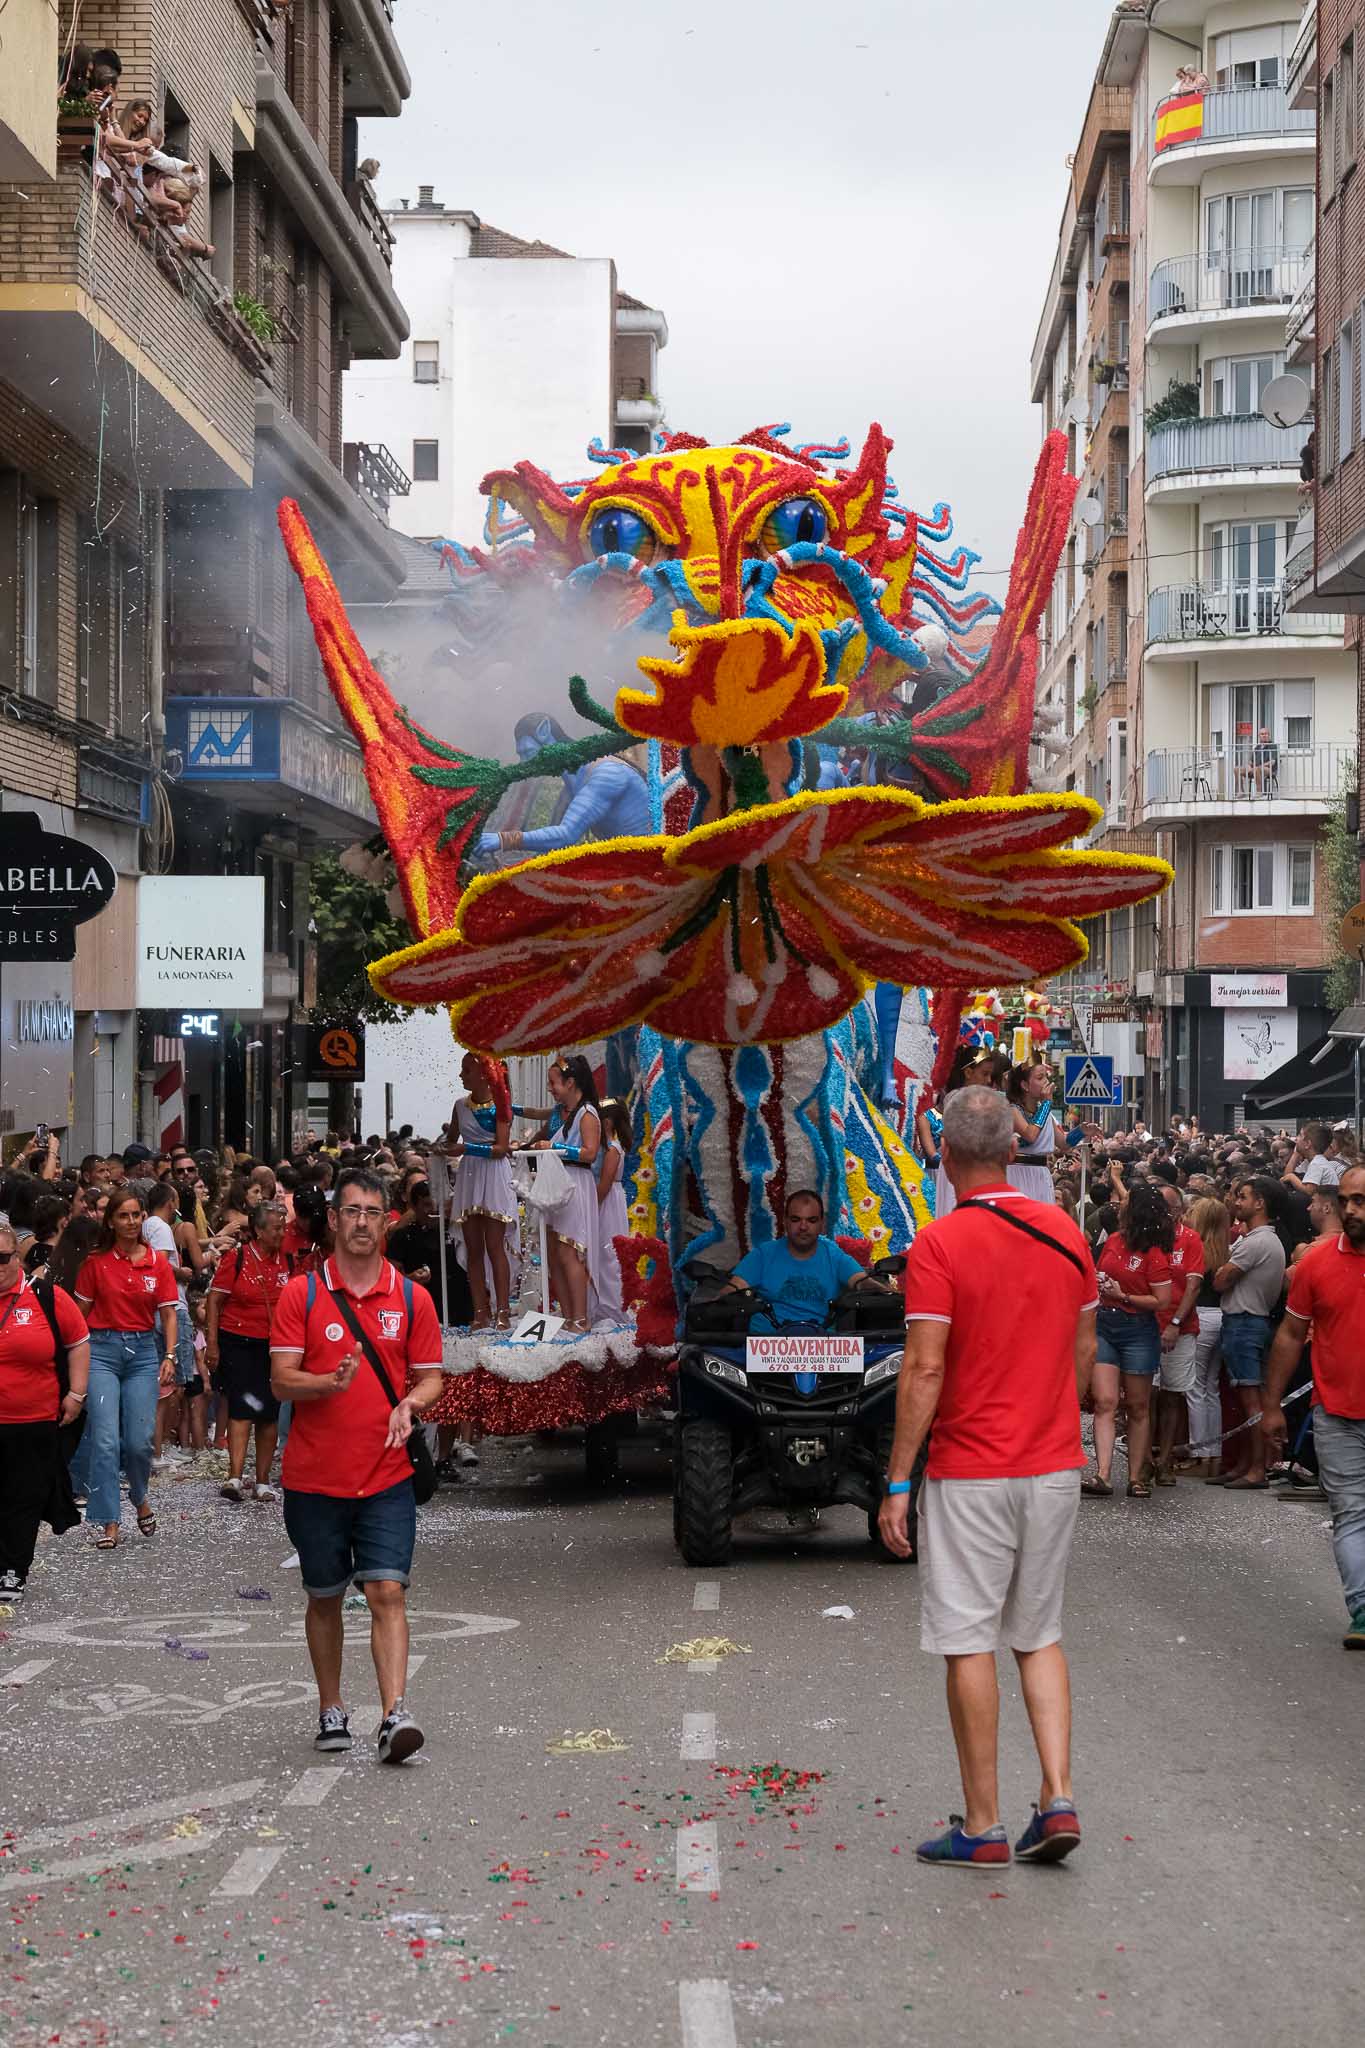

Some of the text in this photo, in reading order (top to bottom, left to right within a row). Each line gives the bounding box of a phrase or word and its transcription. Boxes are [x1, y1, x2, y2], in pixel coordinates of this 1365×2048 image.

[0, 867, 103, 891] BELLA
[146, 946, 246, 961] FUNERARIA
[158, 969, 234, 980] LA MONTAÑESA
[1217, 984, 1281, 999] Tu mejor versión
[1093, 1006, 1126, 1014] ESTAURANTE
[520, 1319, 546, 1342] A
[749, 1339, 861, 1356] VOTOAVENTURA
[761, 1356, 776, 1364] VENTA
[780, 1356, 802, 1365] ALQUILER
[802, 1356, 809, 1364] DE
[809, 1356, 825, 1365] QUADS
